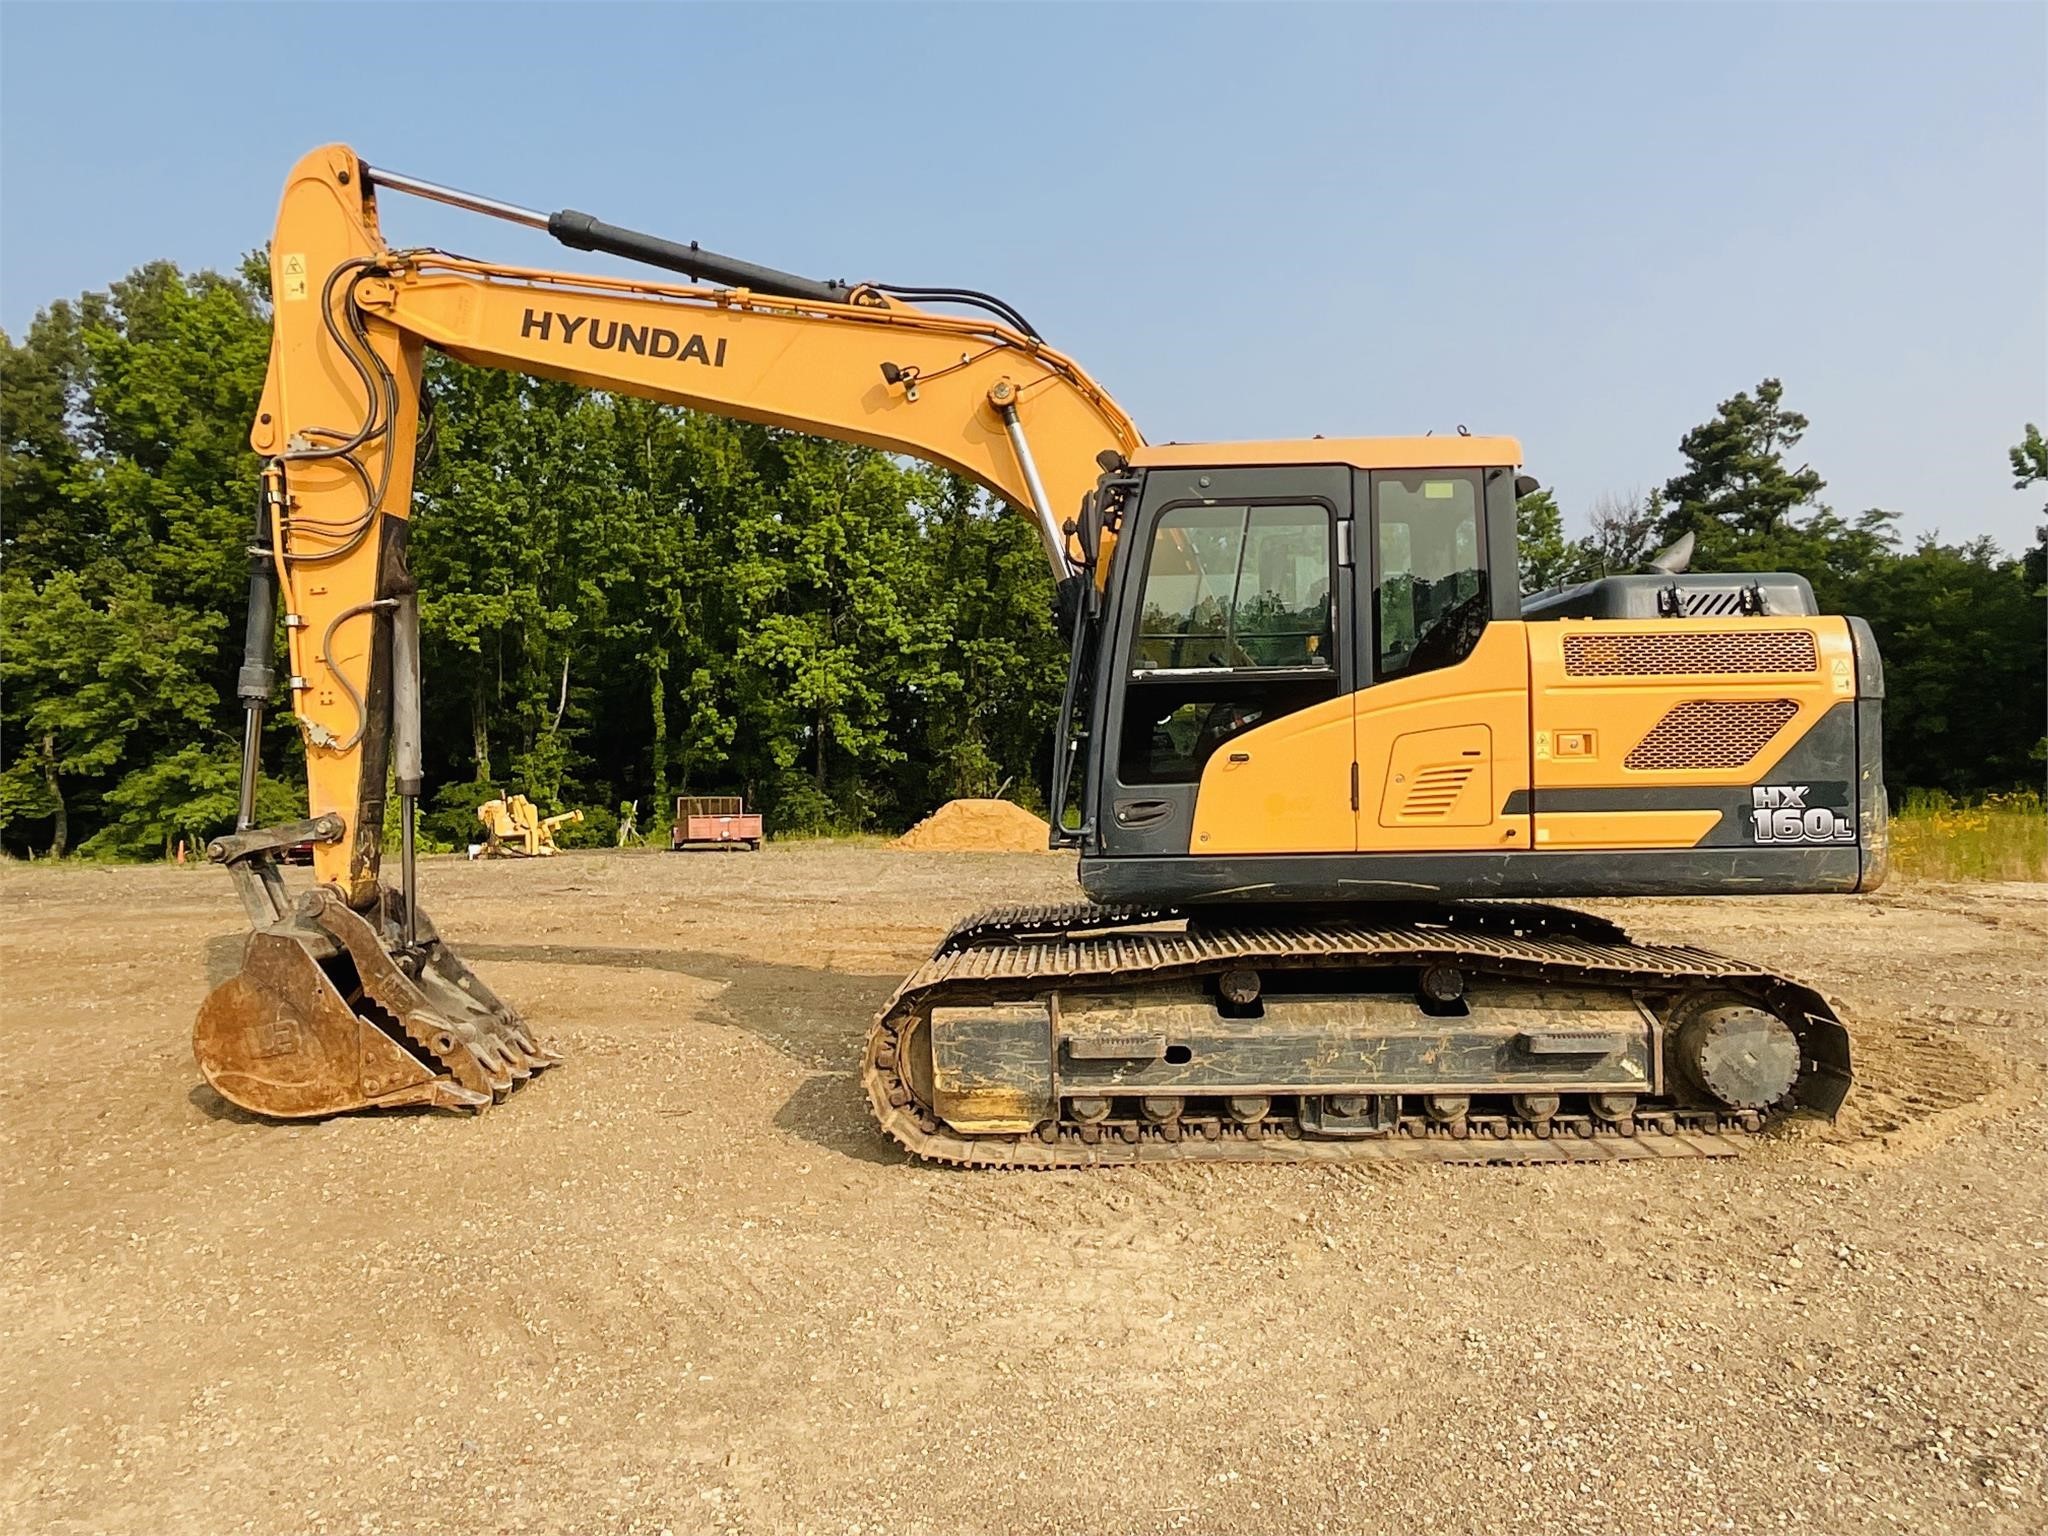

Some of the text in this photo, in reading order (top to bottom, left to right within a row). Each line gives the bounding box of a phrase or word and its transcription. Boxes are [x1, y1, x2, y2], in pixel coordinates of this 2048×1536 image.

[521, 308, 728, 368] HYUNDAI
[1752, 785, 1810, 808] HX
[1750, 807, 1857, 843] 160L
